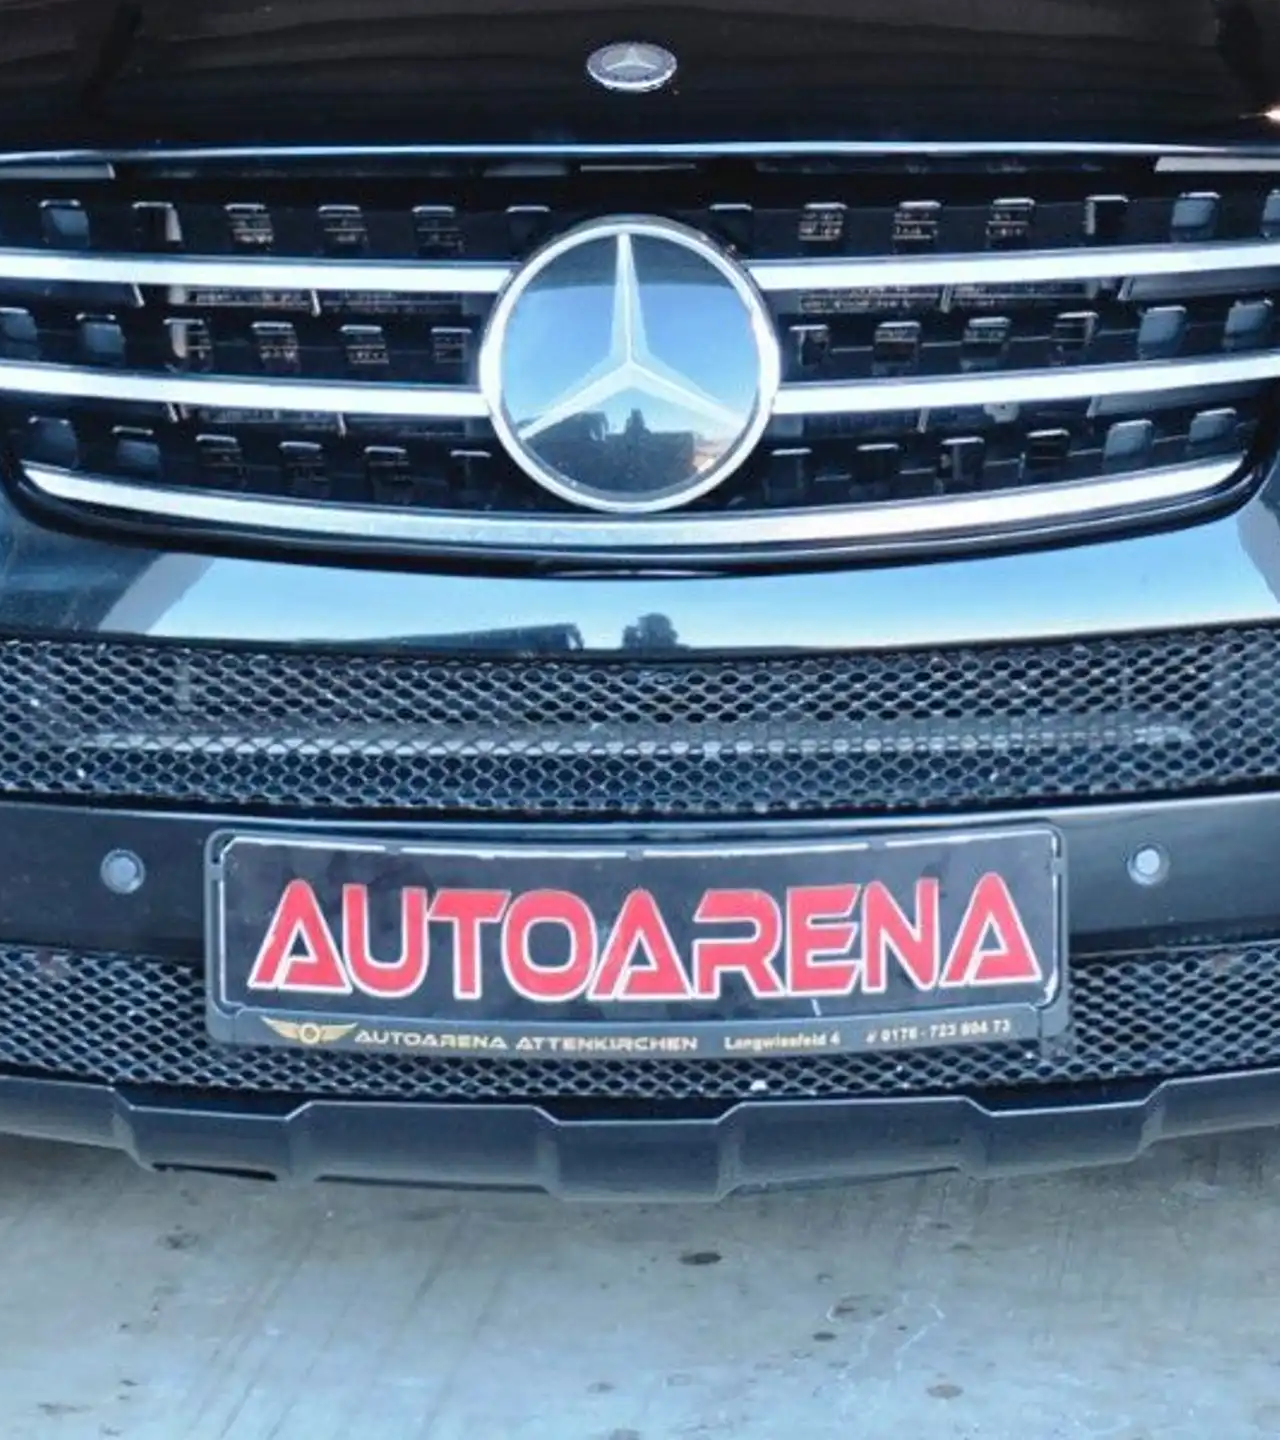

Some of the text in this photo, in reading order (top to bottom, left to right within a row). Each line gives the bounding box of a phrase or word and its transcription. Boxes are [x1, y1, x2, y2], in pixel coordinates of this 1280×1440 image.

[247, 869, 1043, 1002] AUTOARENA
[353, 1028, 509, 1050] AUTOARENA
[514, 1035, 699, 1052] ATTENKIRCHEN
